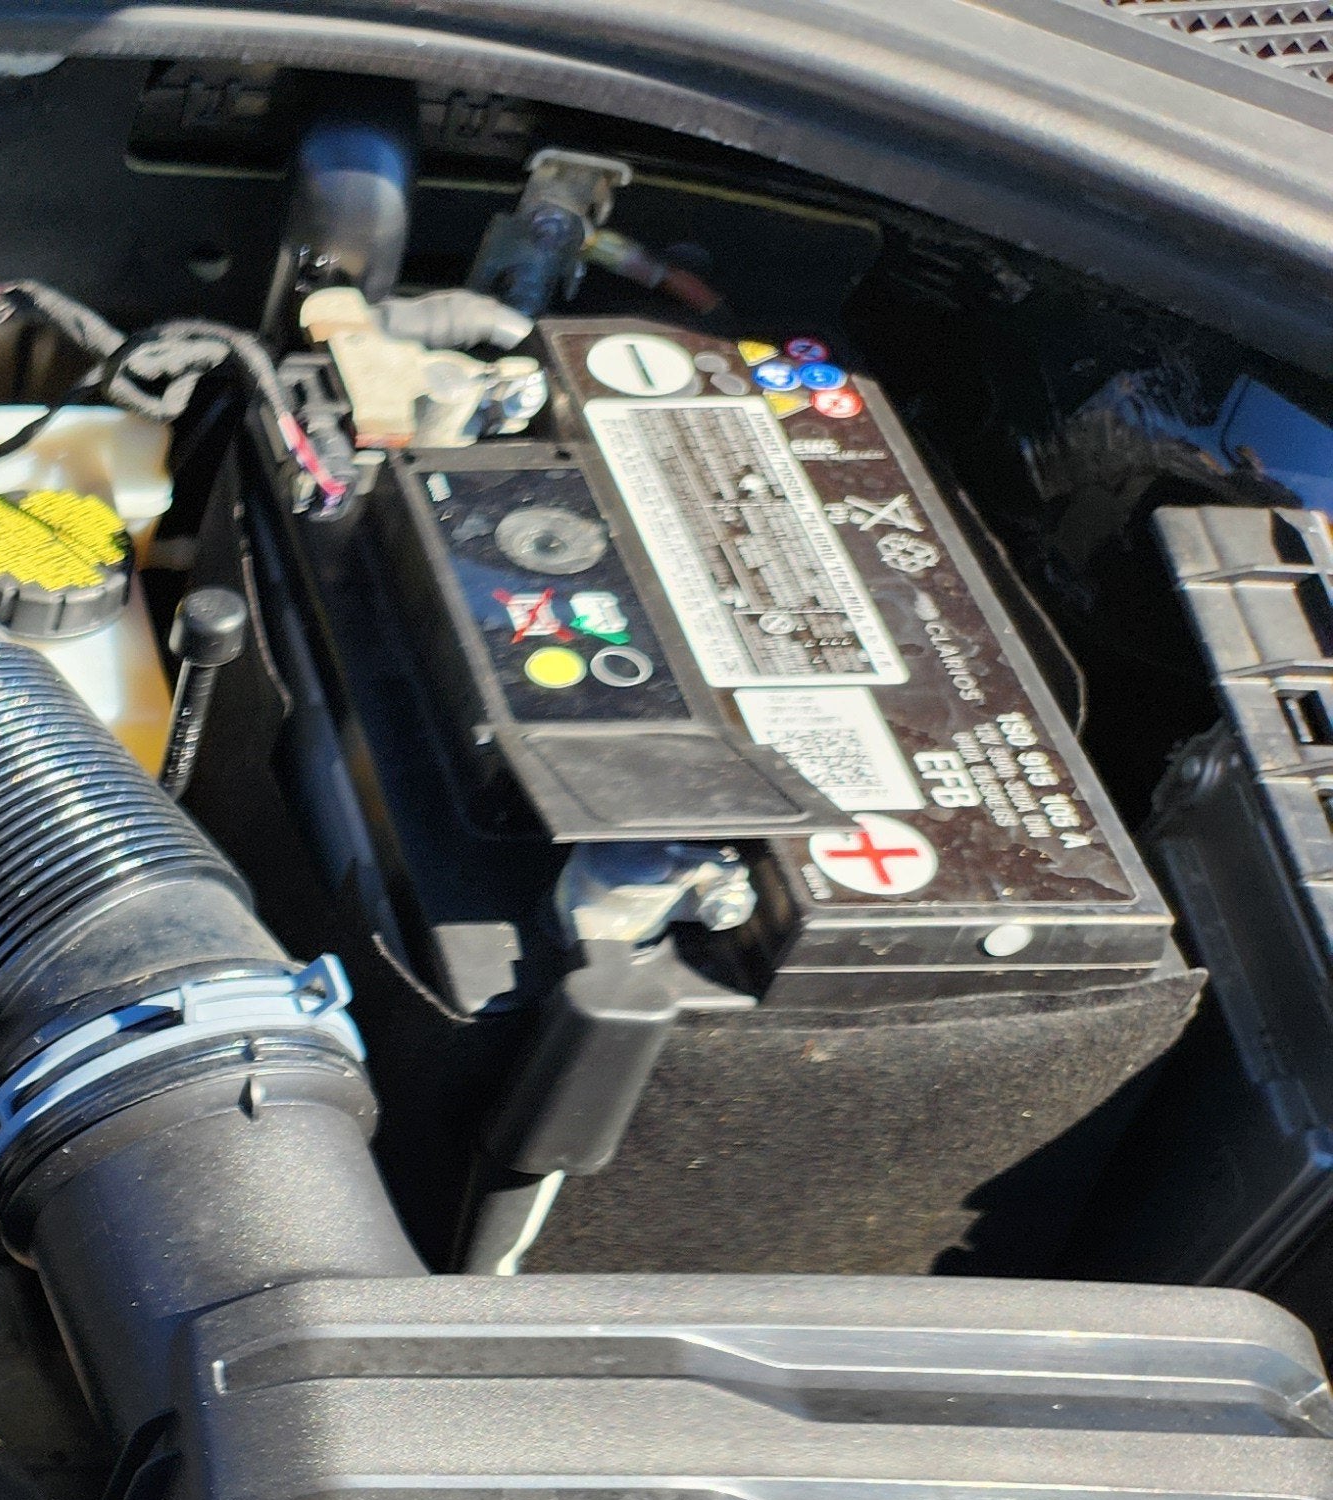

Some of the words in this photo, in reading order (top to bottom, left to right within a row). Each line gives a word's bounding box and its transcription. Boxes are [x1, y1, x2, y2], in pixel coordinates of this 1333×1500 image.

[924, 620, 987, 707] CLARIOS
[912, 750, 983, 809] EFB
[1017, 751, 1061, 786] 915
[1040, 793, 1082, 827] 105
[1058, 832, 1092, 849] A
